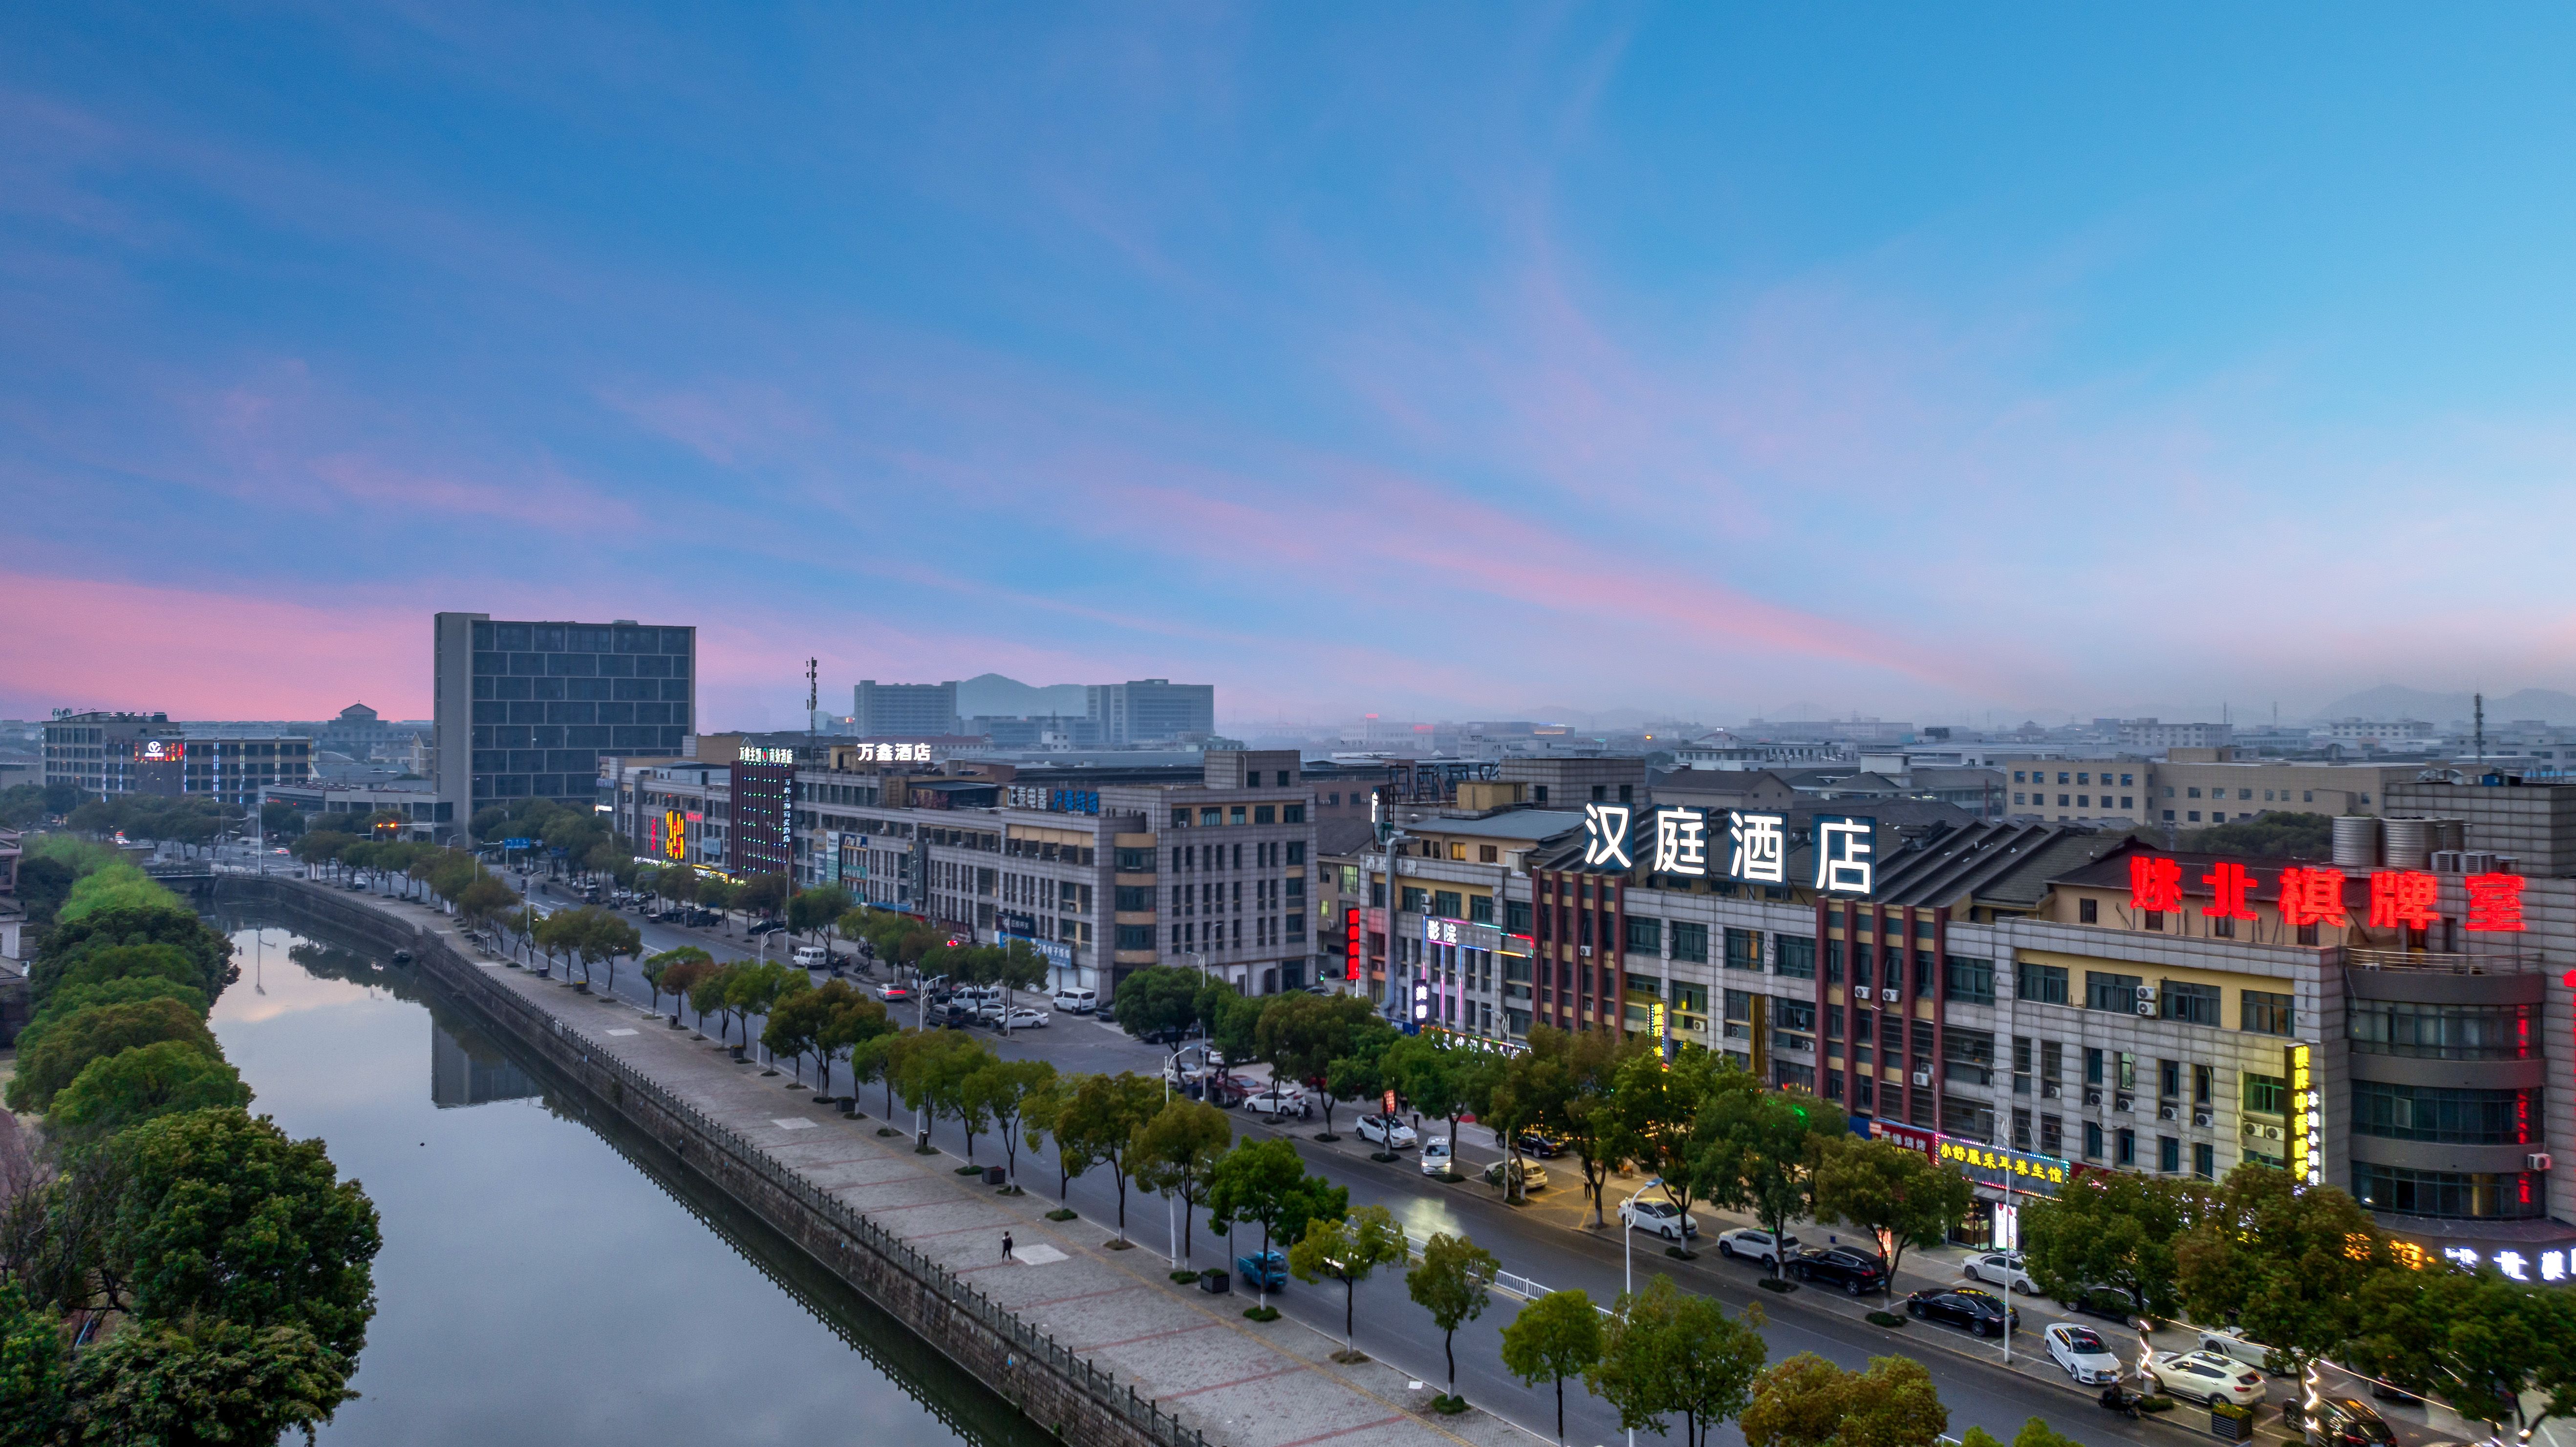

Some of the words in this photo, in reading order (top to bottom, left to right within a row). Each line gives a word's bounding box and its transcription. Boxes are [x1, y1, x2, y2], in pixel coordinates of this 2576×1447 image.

[739, 746, 762, 762] 万鑫主题
[857, 743, 931, 761] 万鑫酒店
[1008, 786, 1047, 809] 正泰电器
[1584, 801, 1872, 894] 汉庭酒店
[1427, 920, 1457, 943] 影院
[1940, 1142, 2063, 1183] 小舒服采耳养生馆
